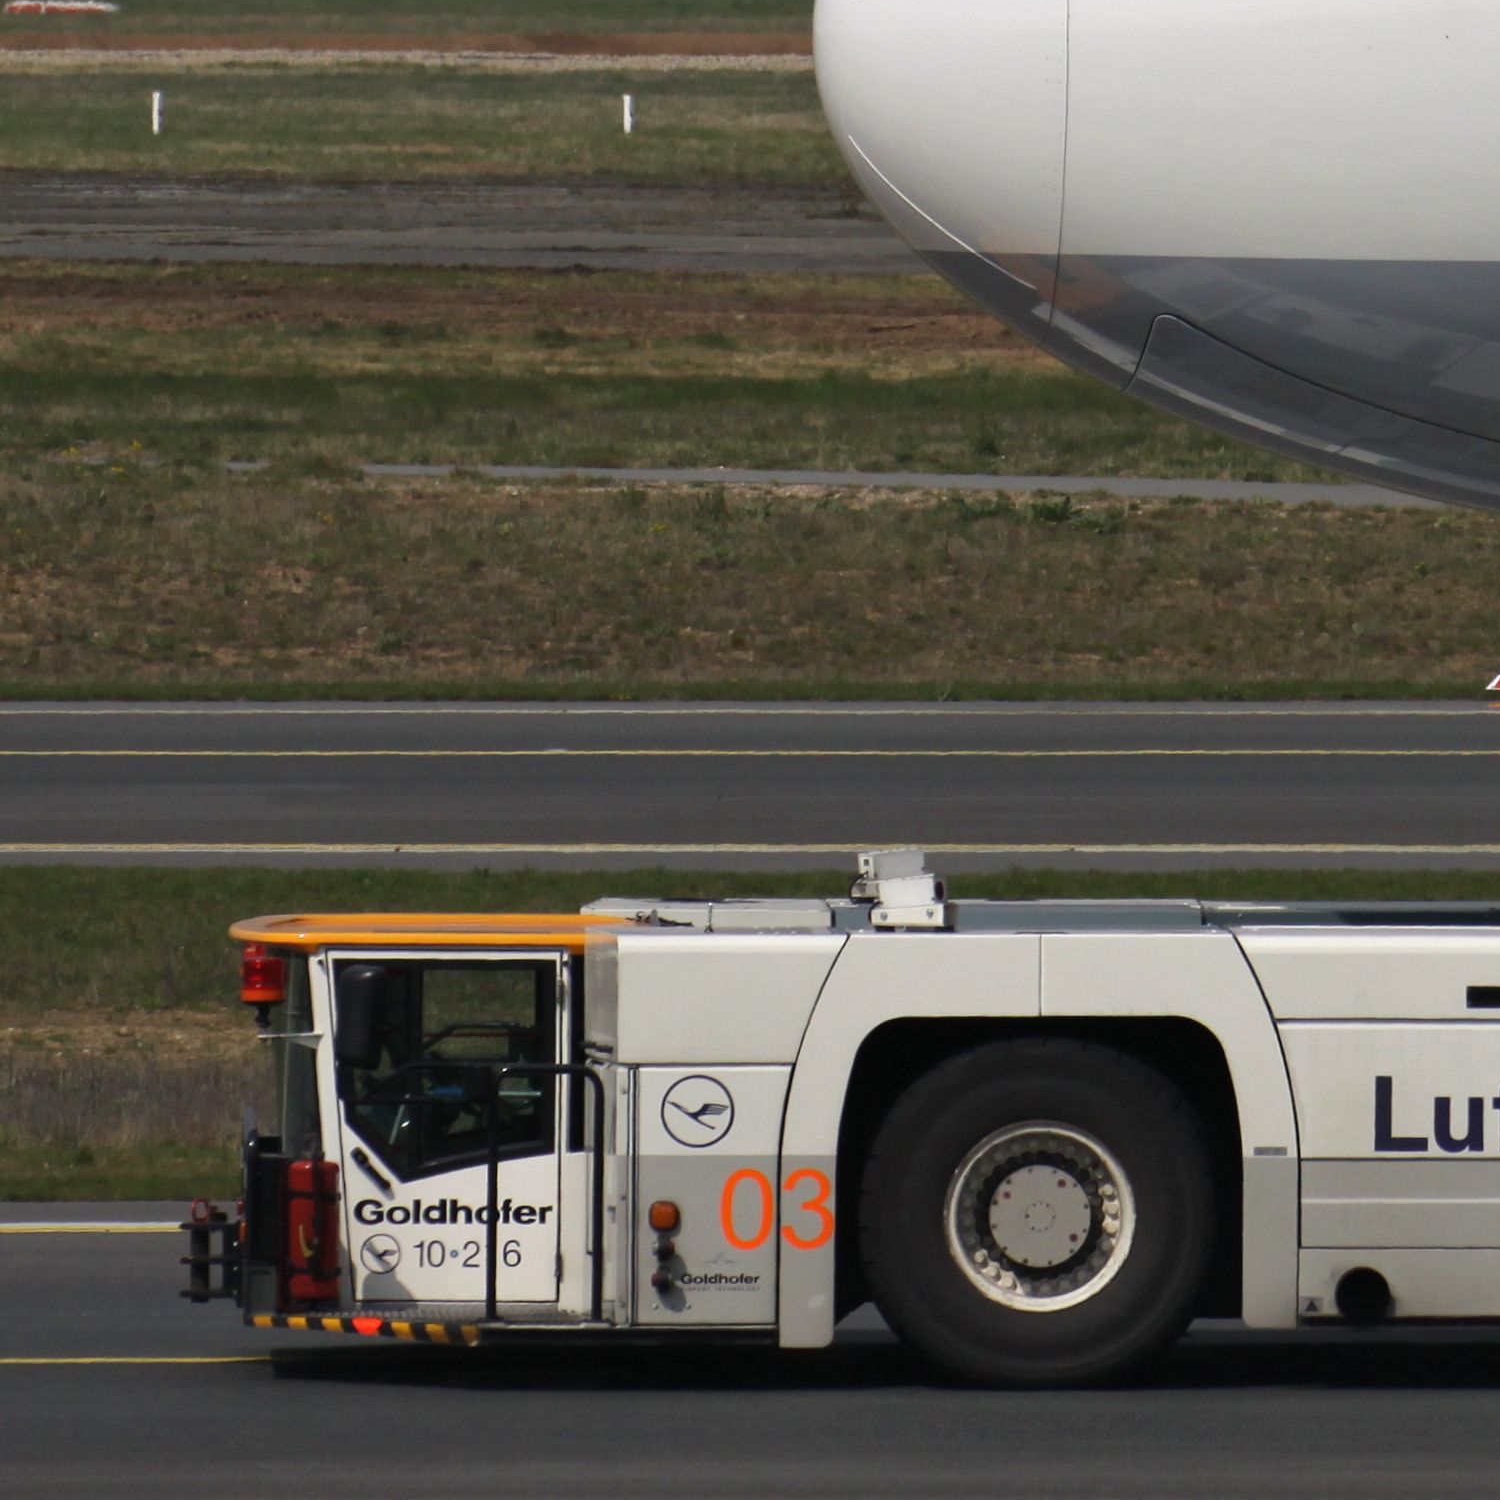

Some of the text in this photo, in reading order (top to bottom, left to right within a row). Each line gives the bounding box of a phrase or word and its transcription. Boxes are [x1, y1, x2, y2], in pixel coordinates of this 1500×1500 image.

[354, 1199, 553, 1225] Goldhofer
[721, 1169, 834, 1249] 03
[681, 1272, 760, 1285] Goldhofer
